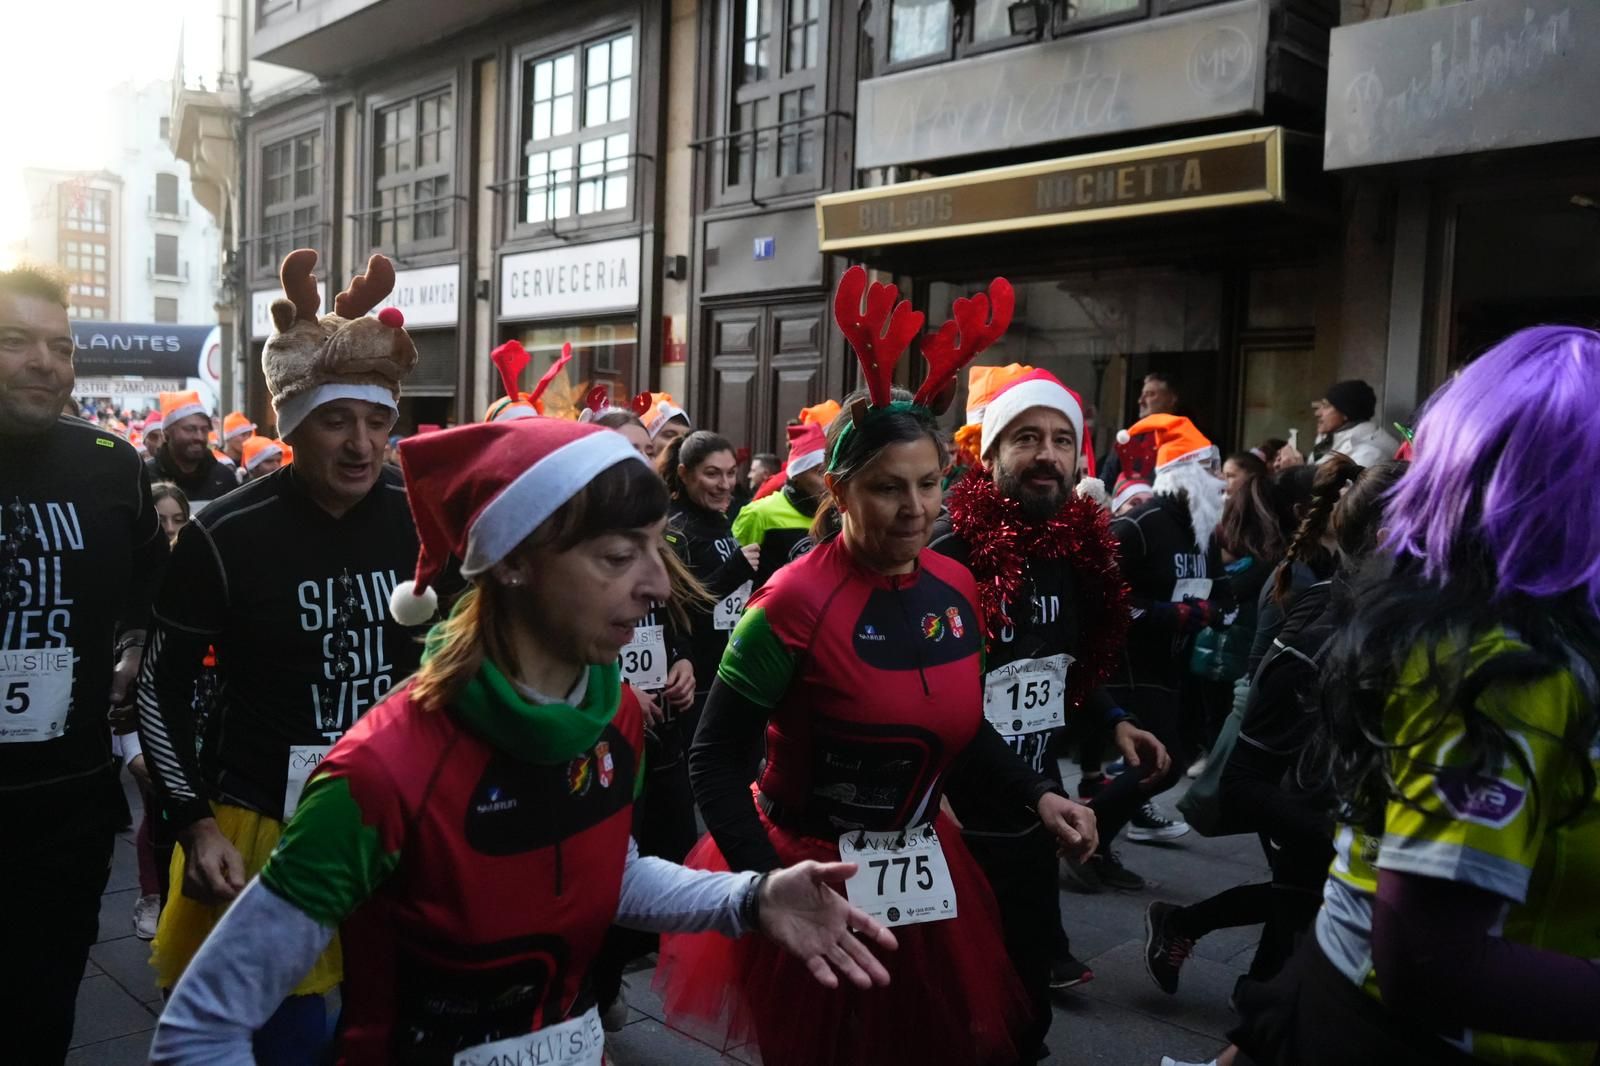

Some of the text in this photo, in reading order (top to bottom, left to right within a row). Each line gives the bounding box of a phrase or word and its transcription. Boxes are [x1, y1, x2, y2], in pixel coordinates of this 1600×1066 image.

[1036, 158, 1202, 210] NOCHETTA
[419, 282, 456, 305] MAYOR
[114, 381, 177, 394] ZAMORANA
[1006, 679, 1050, 711] 153
[868, 855, 934, 896] 775
